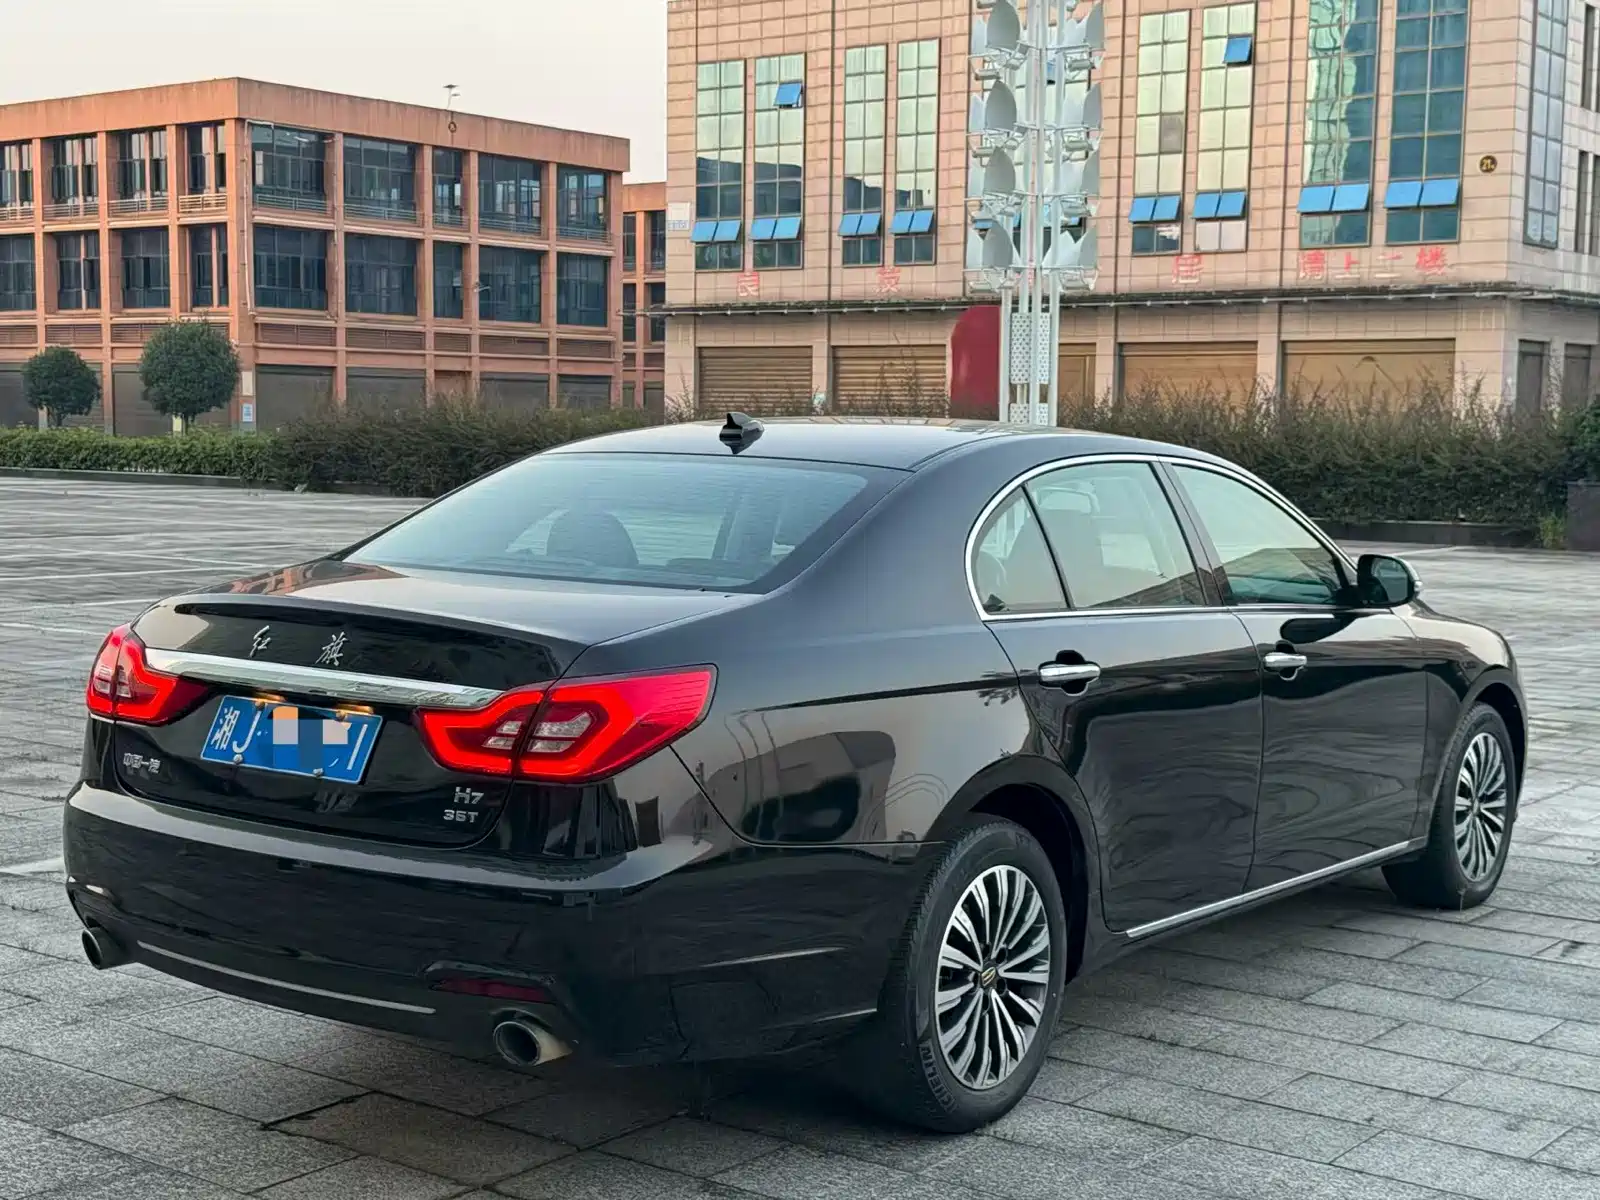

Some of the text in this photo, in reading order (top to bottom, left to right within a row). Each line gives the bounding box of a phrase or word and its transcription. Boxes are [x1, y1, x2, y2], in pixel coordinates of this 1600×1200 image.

[1299, 246, 1447, 281] 请上二楼
[249, 625, 348, 667] 红旗
[123, 752, 161, 774] 中国一汽
[453, 786, 485, 805] H7
[443, 809, 479, 823] 35T
